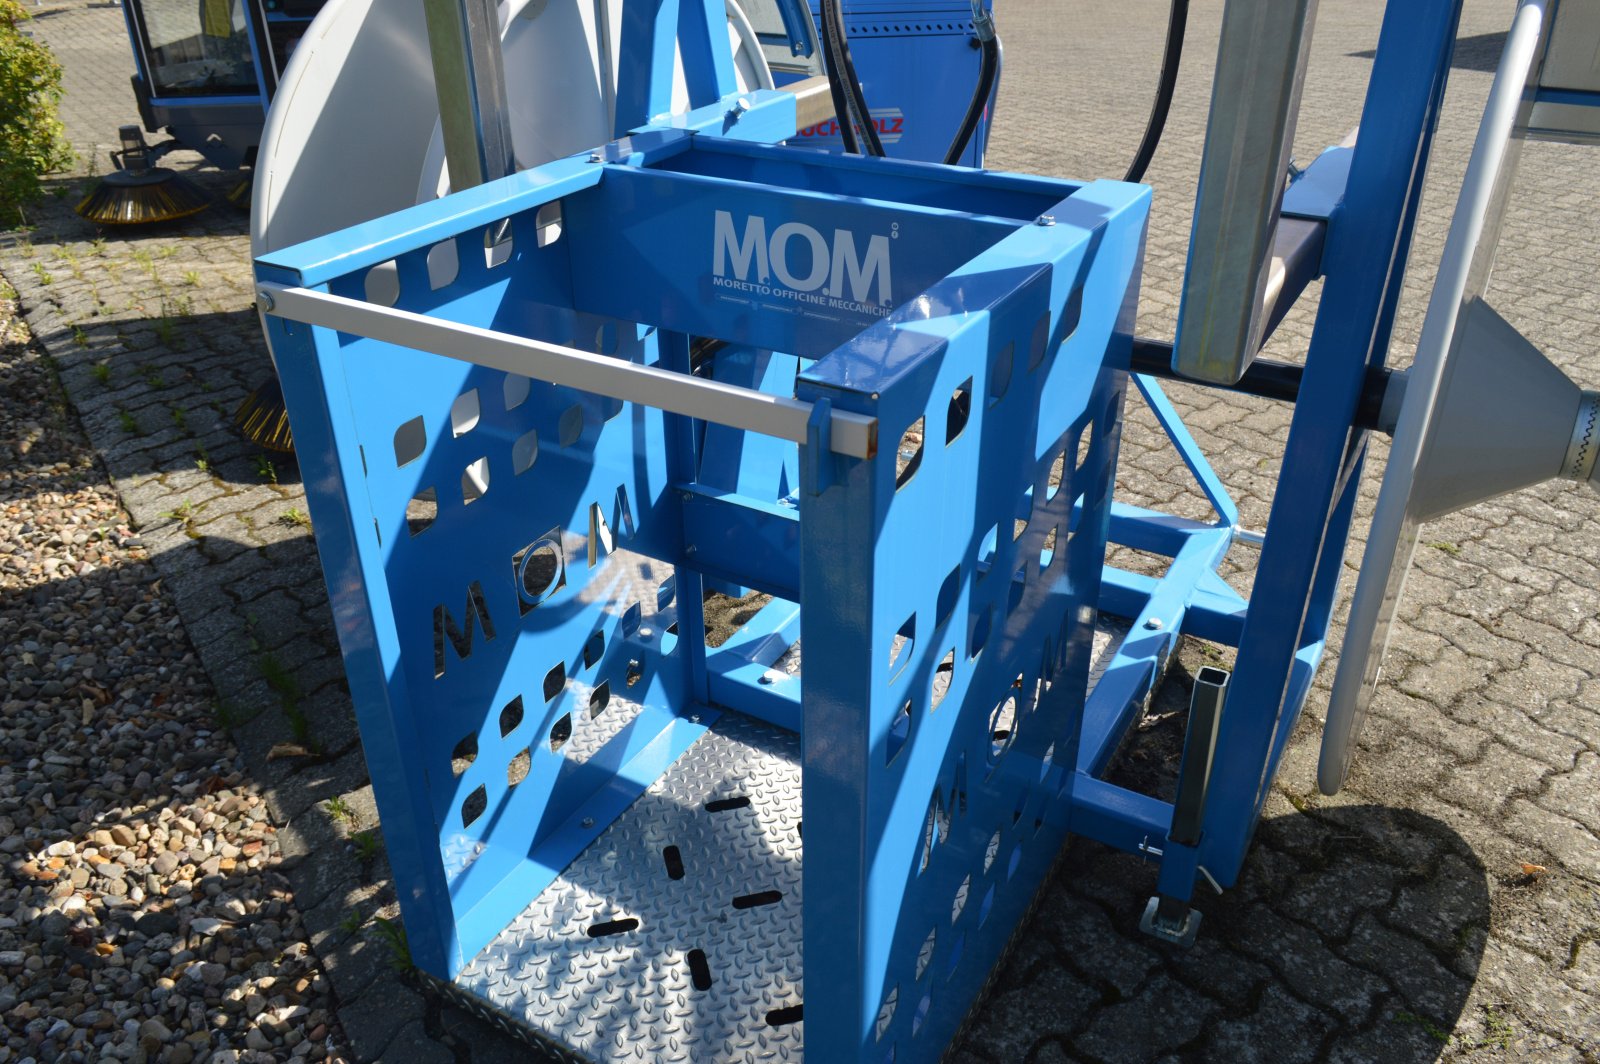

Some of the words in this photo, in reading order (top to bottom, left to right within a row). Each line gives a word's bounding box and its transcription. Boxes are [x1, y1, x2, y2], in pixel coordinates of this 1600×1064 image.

[713, 277, 771, 295] MORETTO
[773, 288, 826, 305] OFFICINE
[828, 298, 892, 317] MECCANICHE
